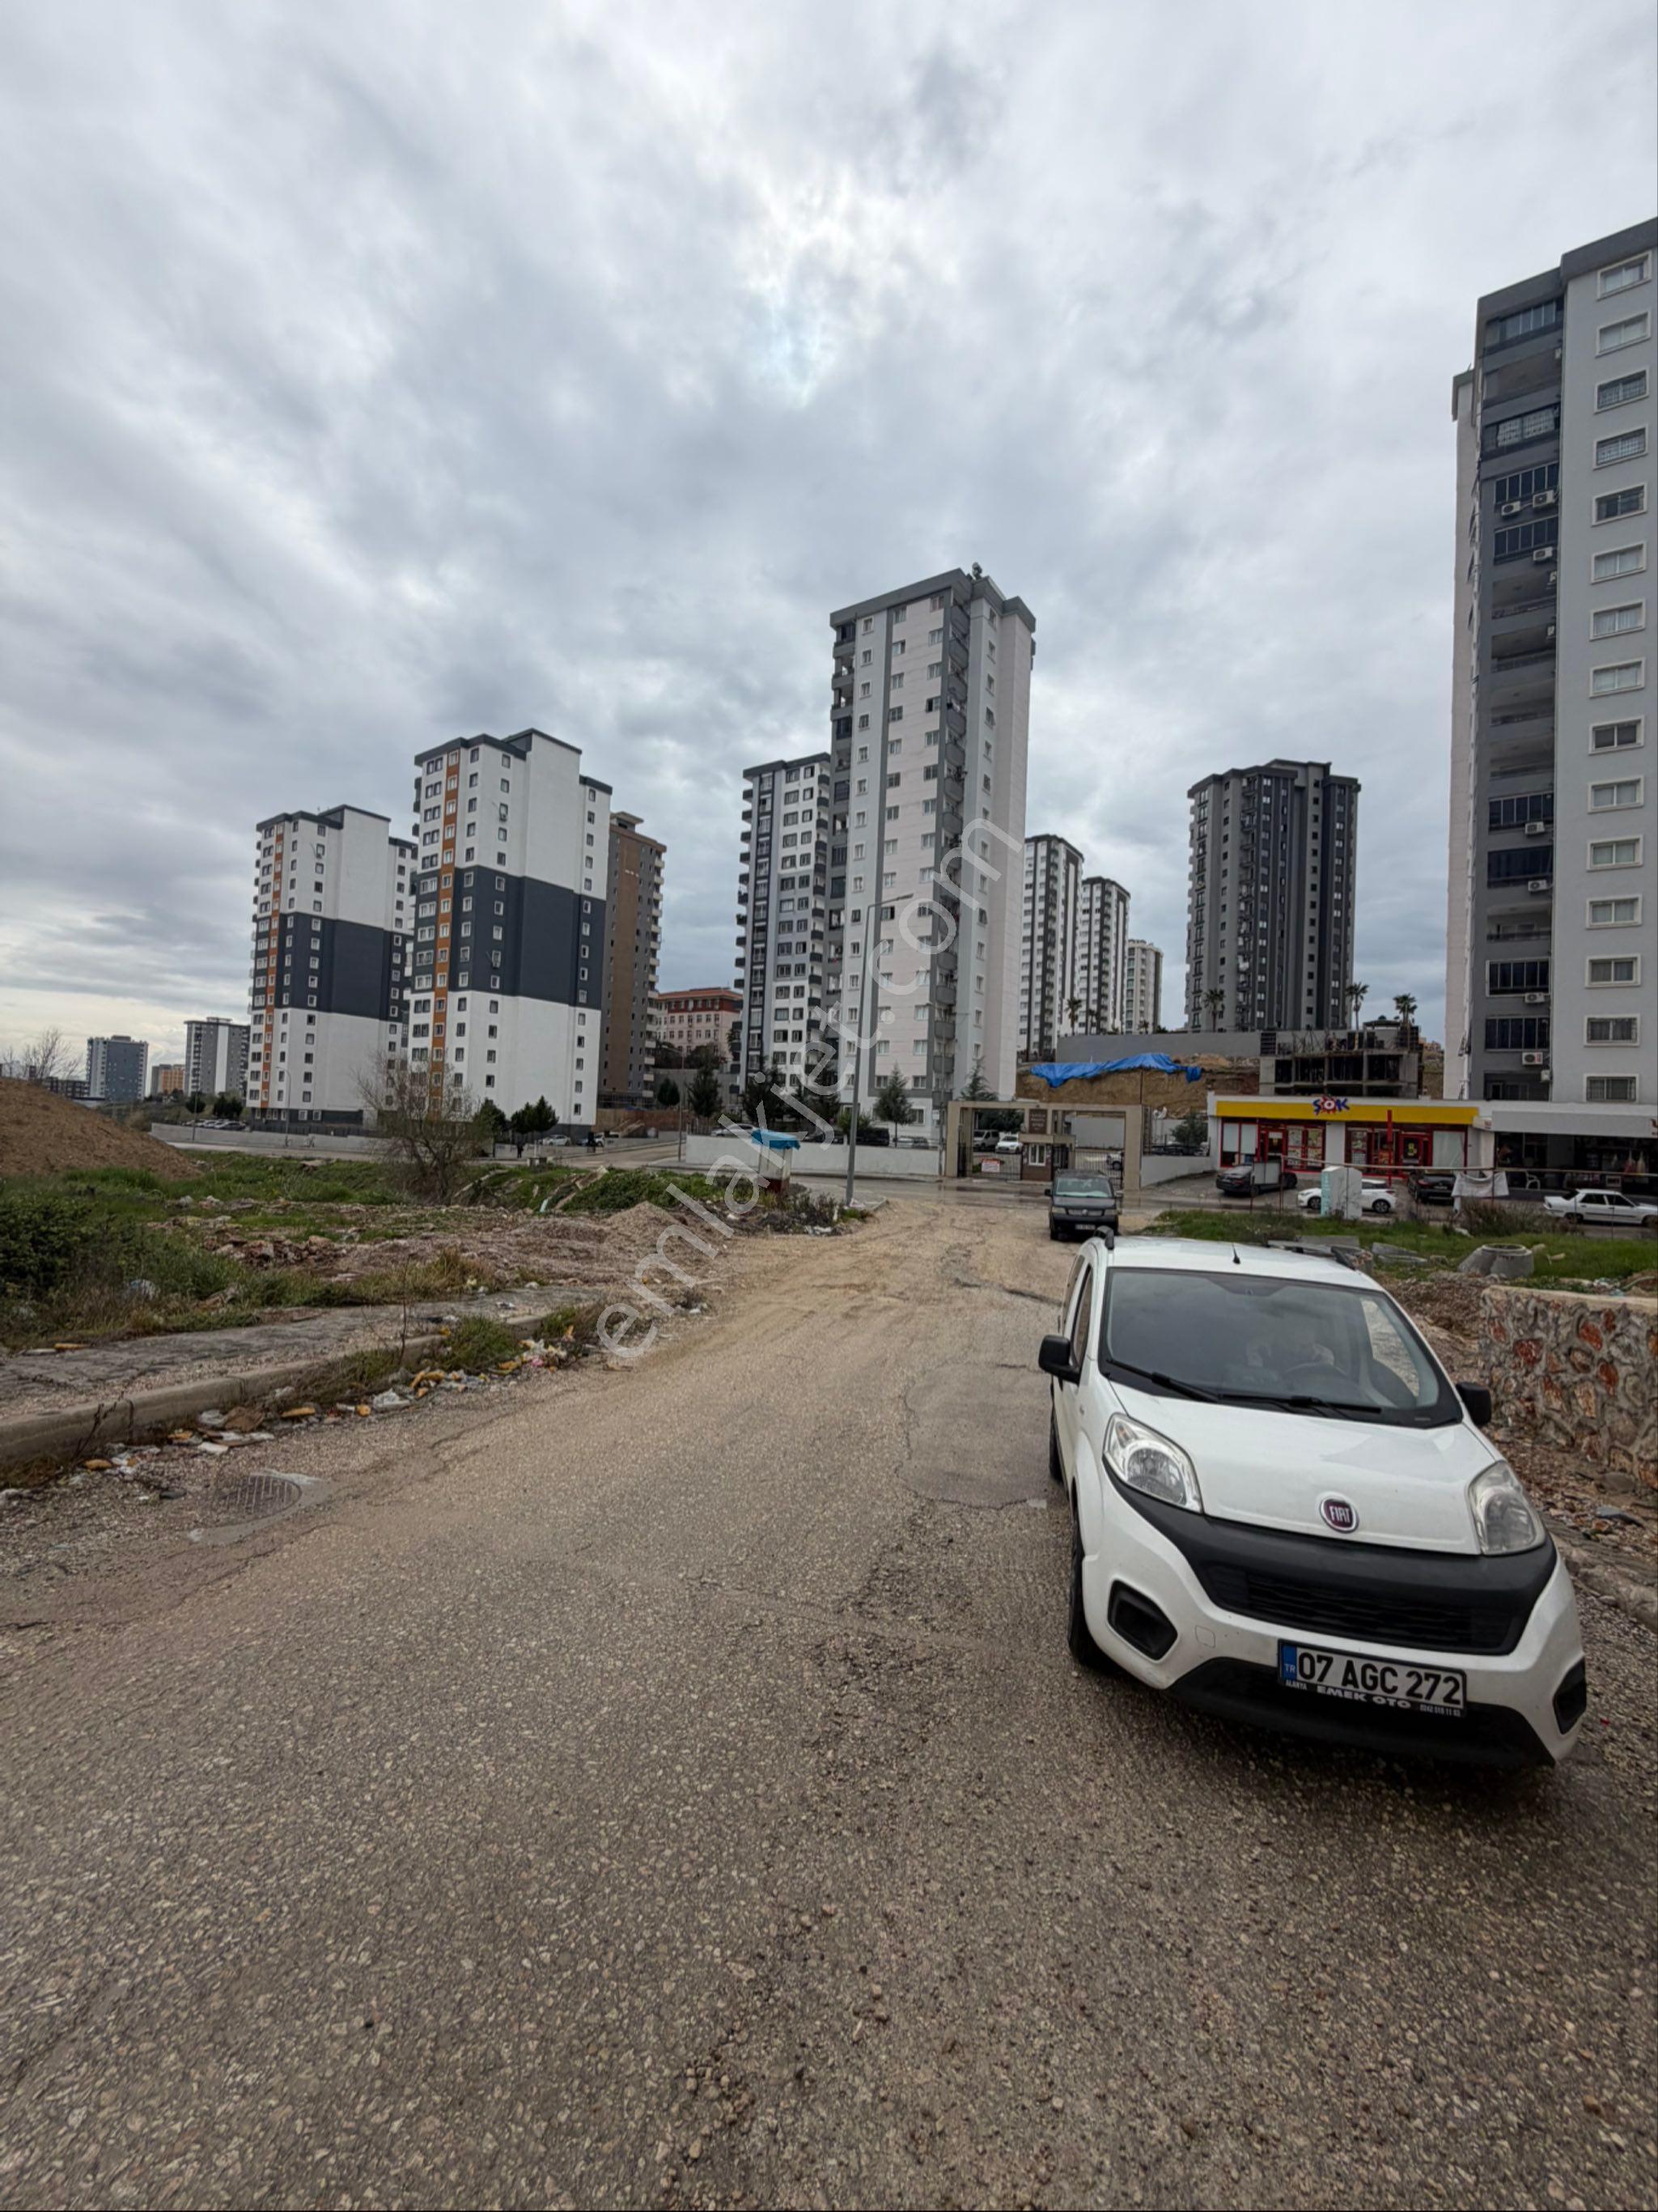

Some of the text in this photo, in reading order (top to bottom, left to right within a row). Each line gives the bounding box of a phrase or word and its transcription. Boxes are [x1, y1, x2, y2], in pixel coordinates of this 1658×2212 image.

[1329, 1505, 1351, 1523] FIAT
[1284, 1663, 1295, 1672] TR
[1298, 1652, 1461, 1705] 07 AGC 272
[1317, 1685, 1411, 1709] EMEK OTO
